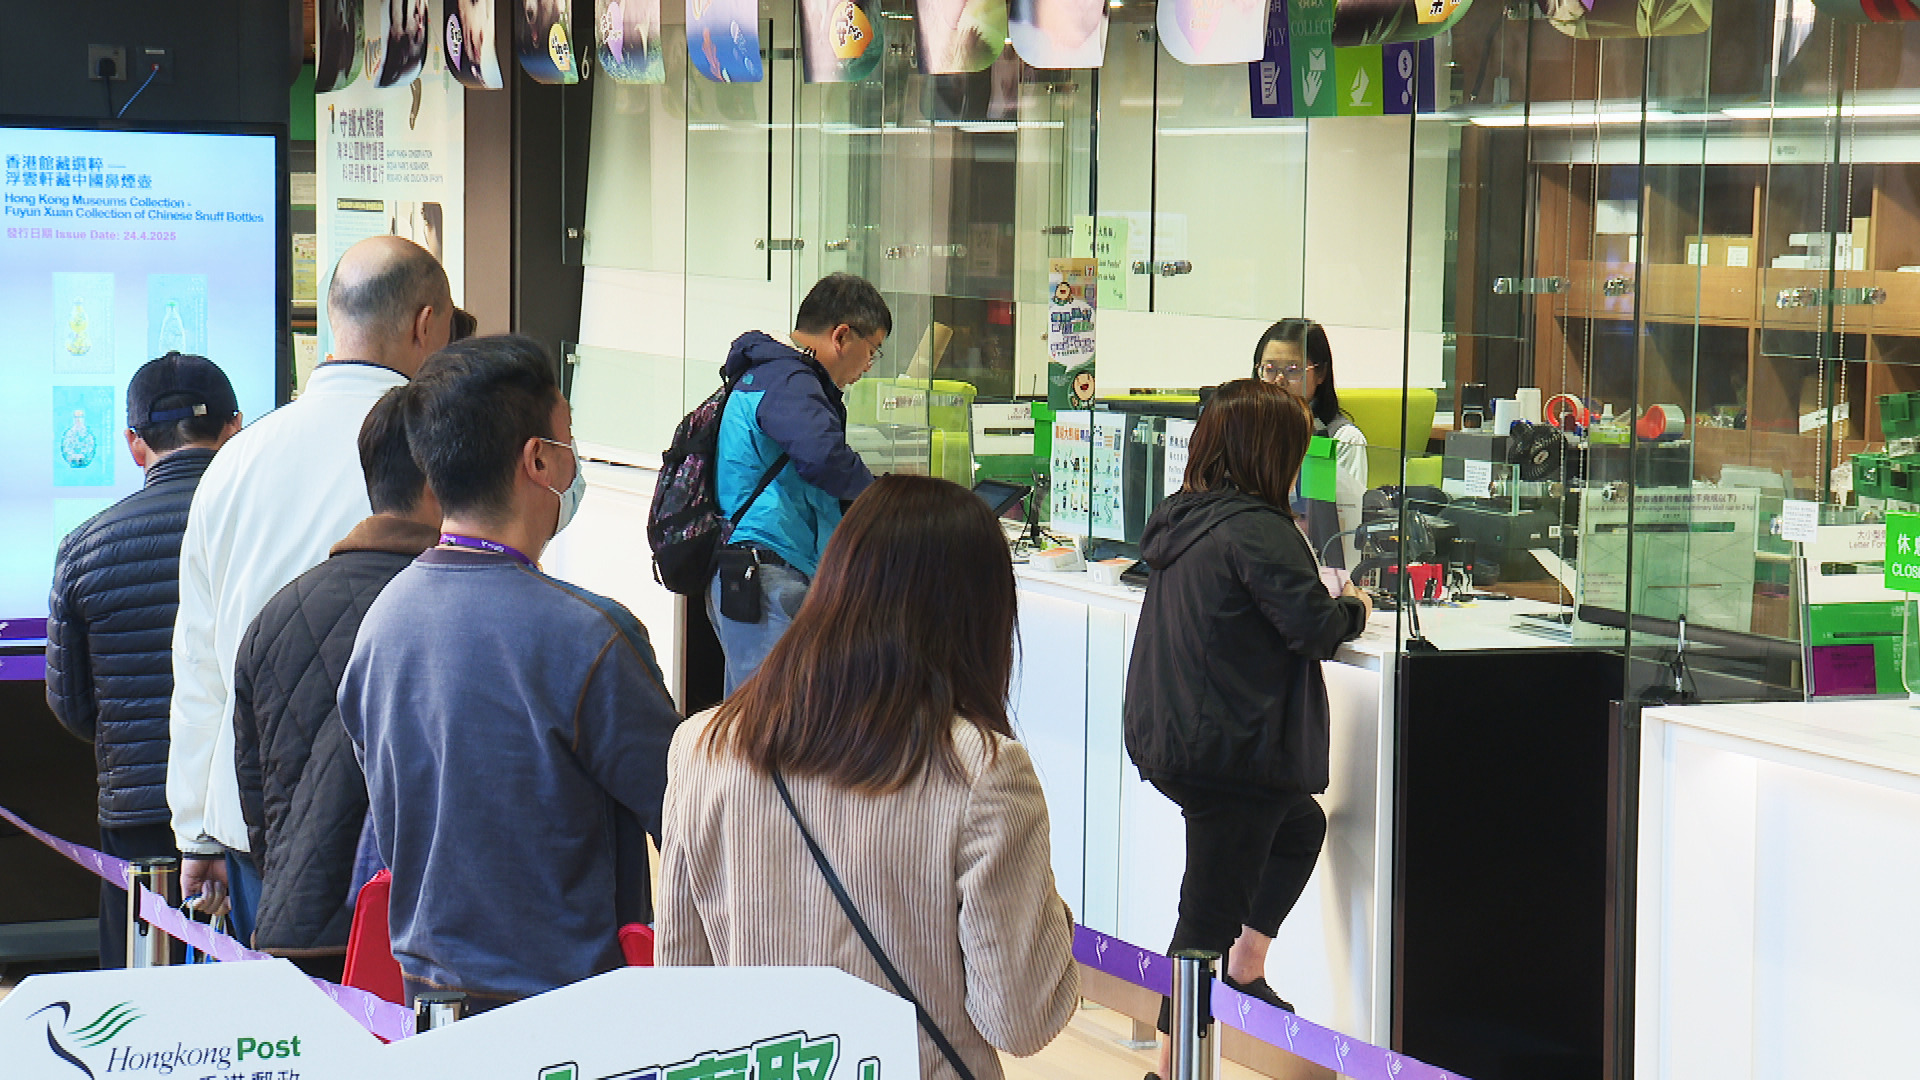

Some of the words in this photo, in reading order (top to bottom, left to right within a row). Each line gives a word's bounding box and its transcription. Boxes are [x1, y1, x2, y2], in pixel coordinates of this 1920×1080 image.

[1267, 28, 1286, 46] PLY
[340, 108, 383, 138] 守護大熊貓
[5, 192, 36, 206] Hong
[39, 193, 70, 207] Kong
[73, 195, 127, 206] Museums
[130, 196, 185, 208] Collection
[5, 206, 41, 218] Fuyun
[43, 207, 73, 217] Xuan
[76, 208, 132, 219] Collection
[134, 208, 145, 219] of
[148, 209, 193, 220] Chinese
[195, 211, 224, 222] Snuff
[226, 212, 264, 223] Bottles
[7, 228, 53, 239] 發行日期
[56, 230, 87, 240] Issue
[90, 230, 120, 241] Date:
[123, 231, 177, 241] 24.4.2025
[1848, 541, 1870, 549] Letter
[106, 1042, 232, 1075] Hongkong
[237, 1035, 301, 1061] Post
